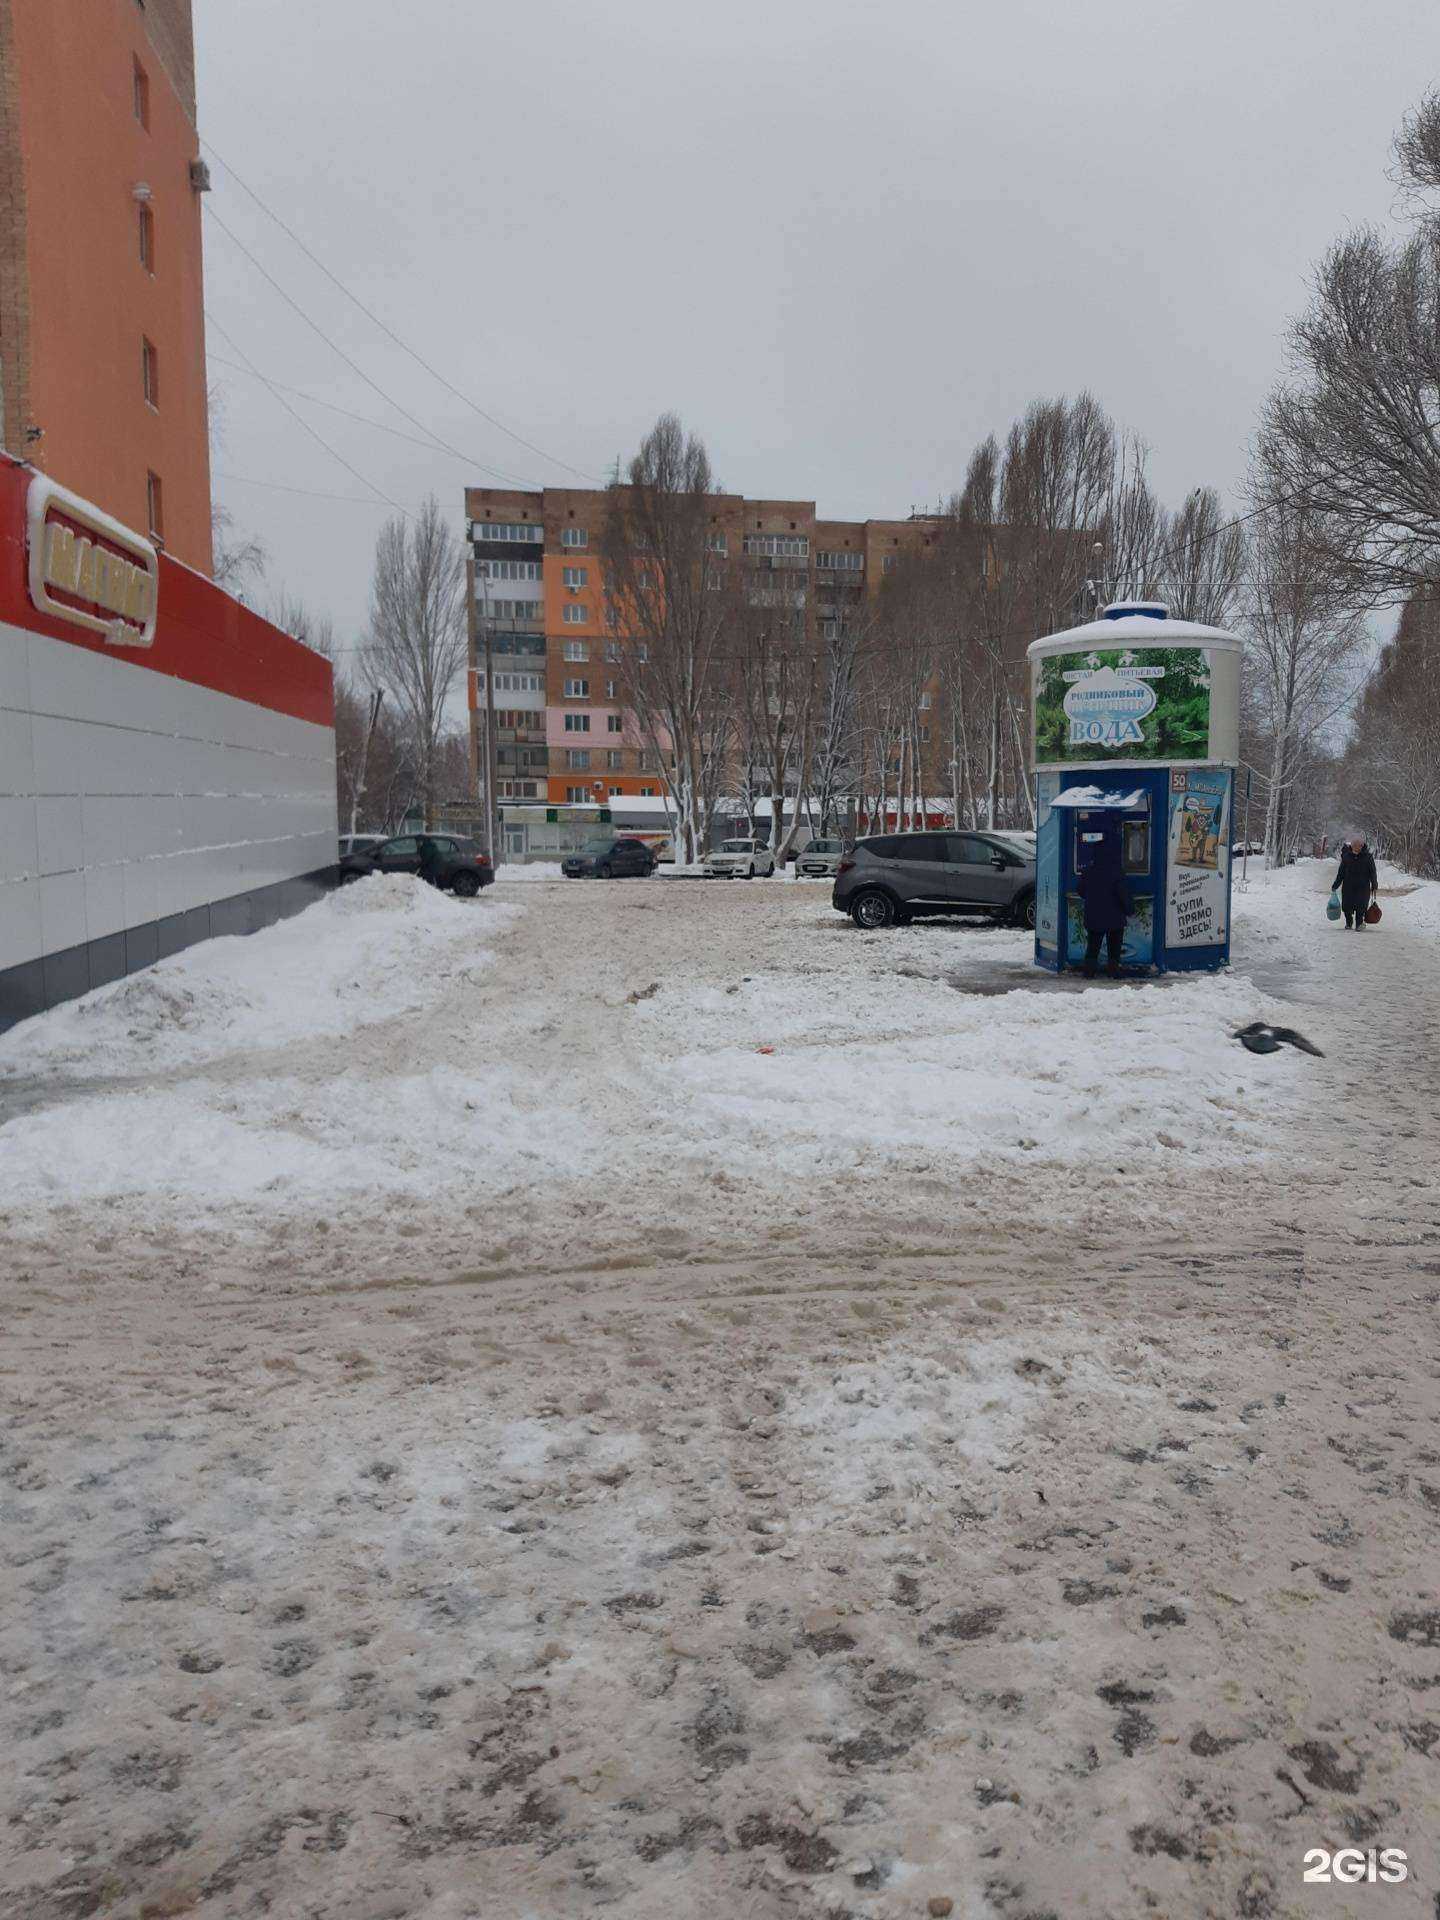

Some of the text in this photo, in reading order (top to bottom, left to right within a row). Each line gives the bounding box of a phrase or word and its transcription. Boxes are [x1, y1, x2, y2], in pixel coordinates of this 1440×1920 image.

[1073, 720, 1140, 743] ВОДА
[1173, 774, 1186, 786] 50
[1176, 897, 1203, 914] КУПИ
[1178, 907, 1212, 927] ПРЯМО
[1178, 919, 1212, 940] ЗДЕСЬ!
